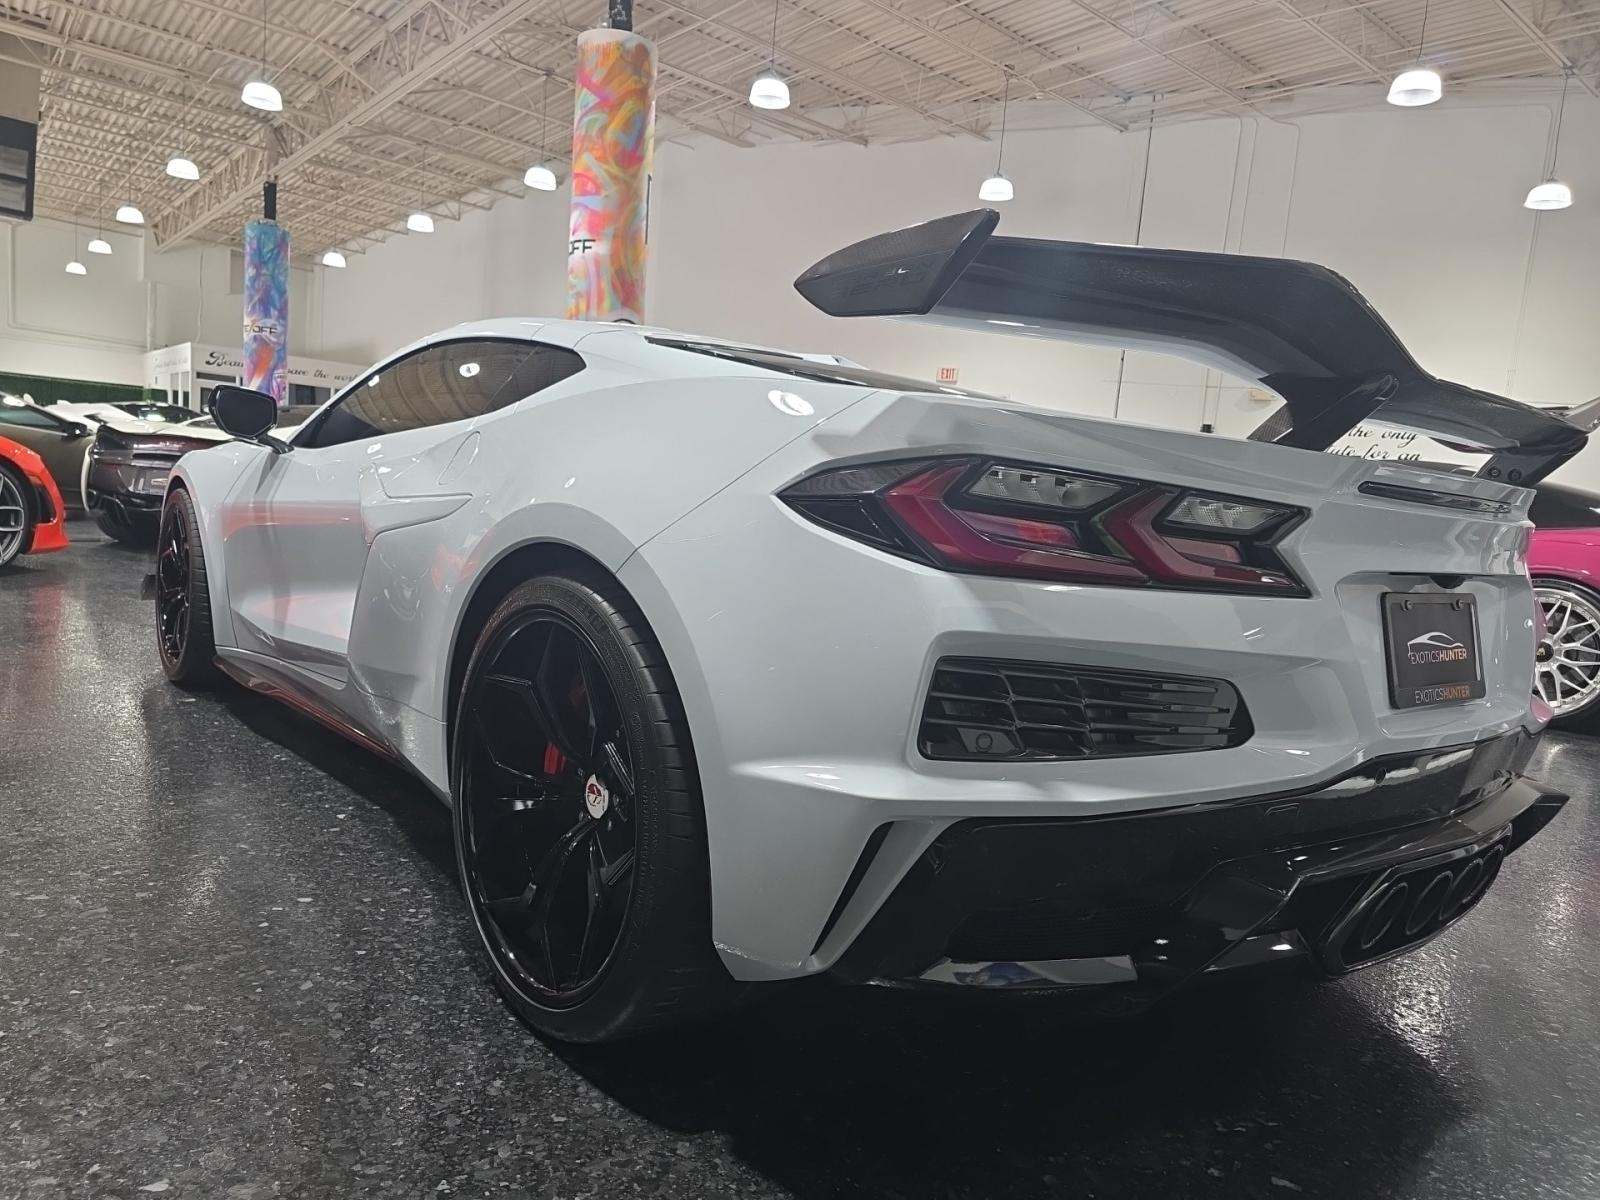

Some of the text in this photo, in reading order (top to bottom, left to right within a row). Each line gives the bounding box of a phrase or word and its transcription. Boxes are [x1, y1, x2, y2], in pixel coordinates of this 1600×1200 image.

[940, 367, 956, 380] EXIT
[1348, 425, 1373, 437] the
[1398, 452, 1421, 461] an
